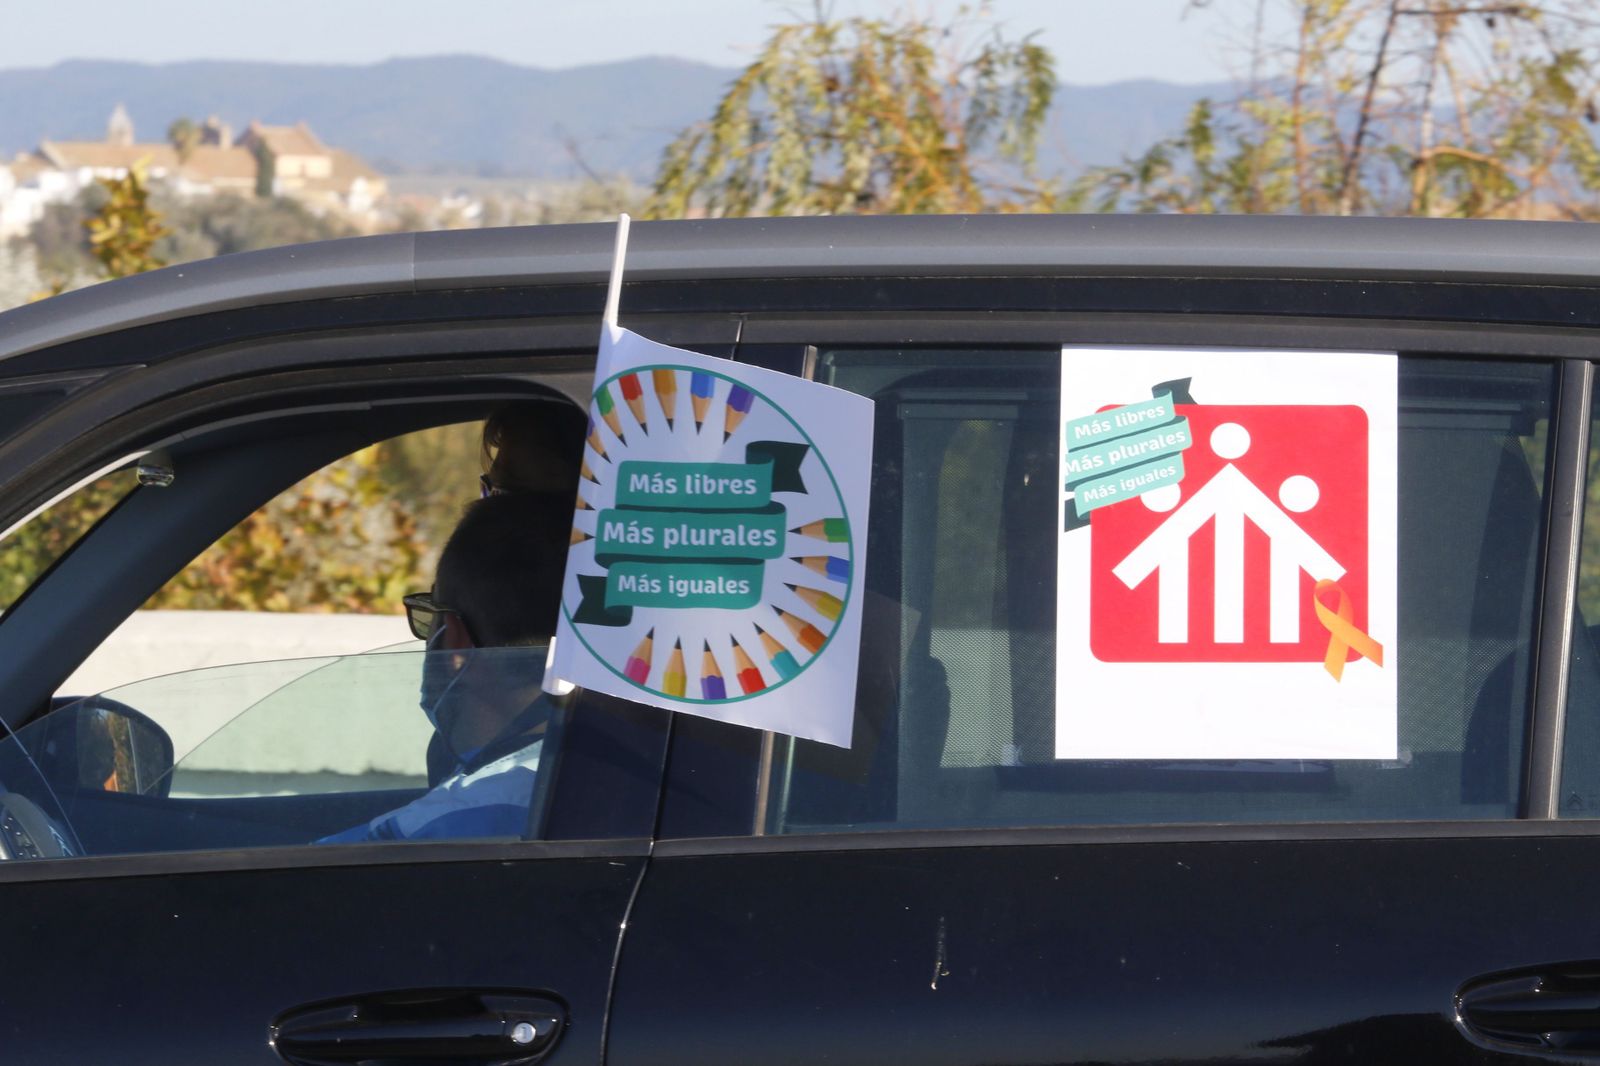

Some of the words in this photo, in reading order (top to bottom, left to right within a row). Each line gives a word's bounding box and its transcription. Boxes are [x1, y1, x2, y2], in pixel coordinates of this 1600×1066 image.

[1074, 418, 1111, 439] Más
[1115, 405, 1165, 427] libres
[1065, 455, 1105, 476] Más
[1108, 431, 1186, 465] plurales
[629, 472, 677, 495] Más
[685, 473, 757, 496] libres
[1083, 483, 1117, 503] Más
[1119, 465, 1176, 492] iguales
[603, 520, 655, 545] Más
[663, 523, 778, 549] plurales
[617, 574, 661, 594] Más
[668, 575, 750, 598] iguales
